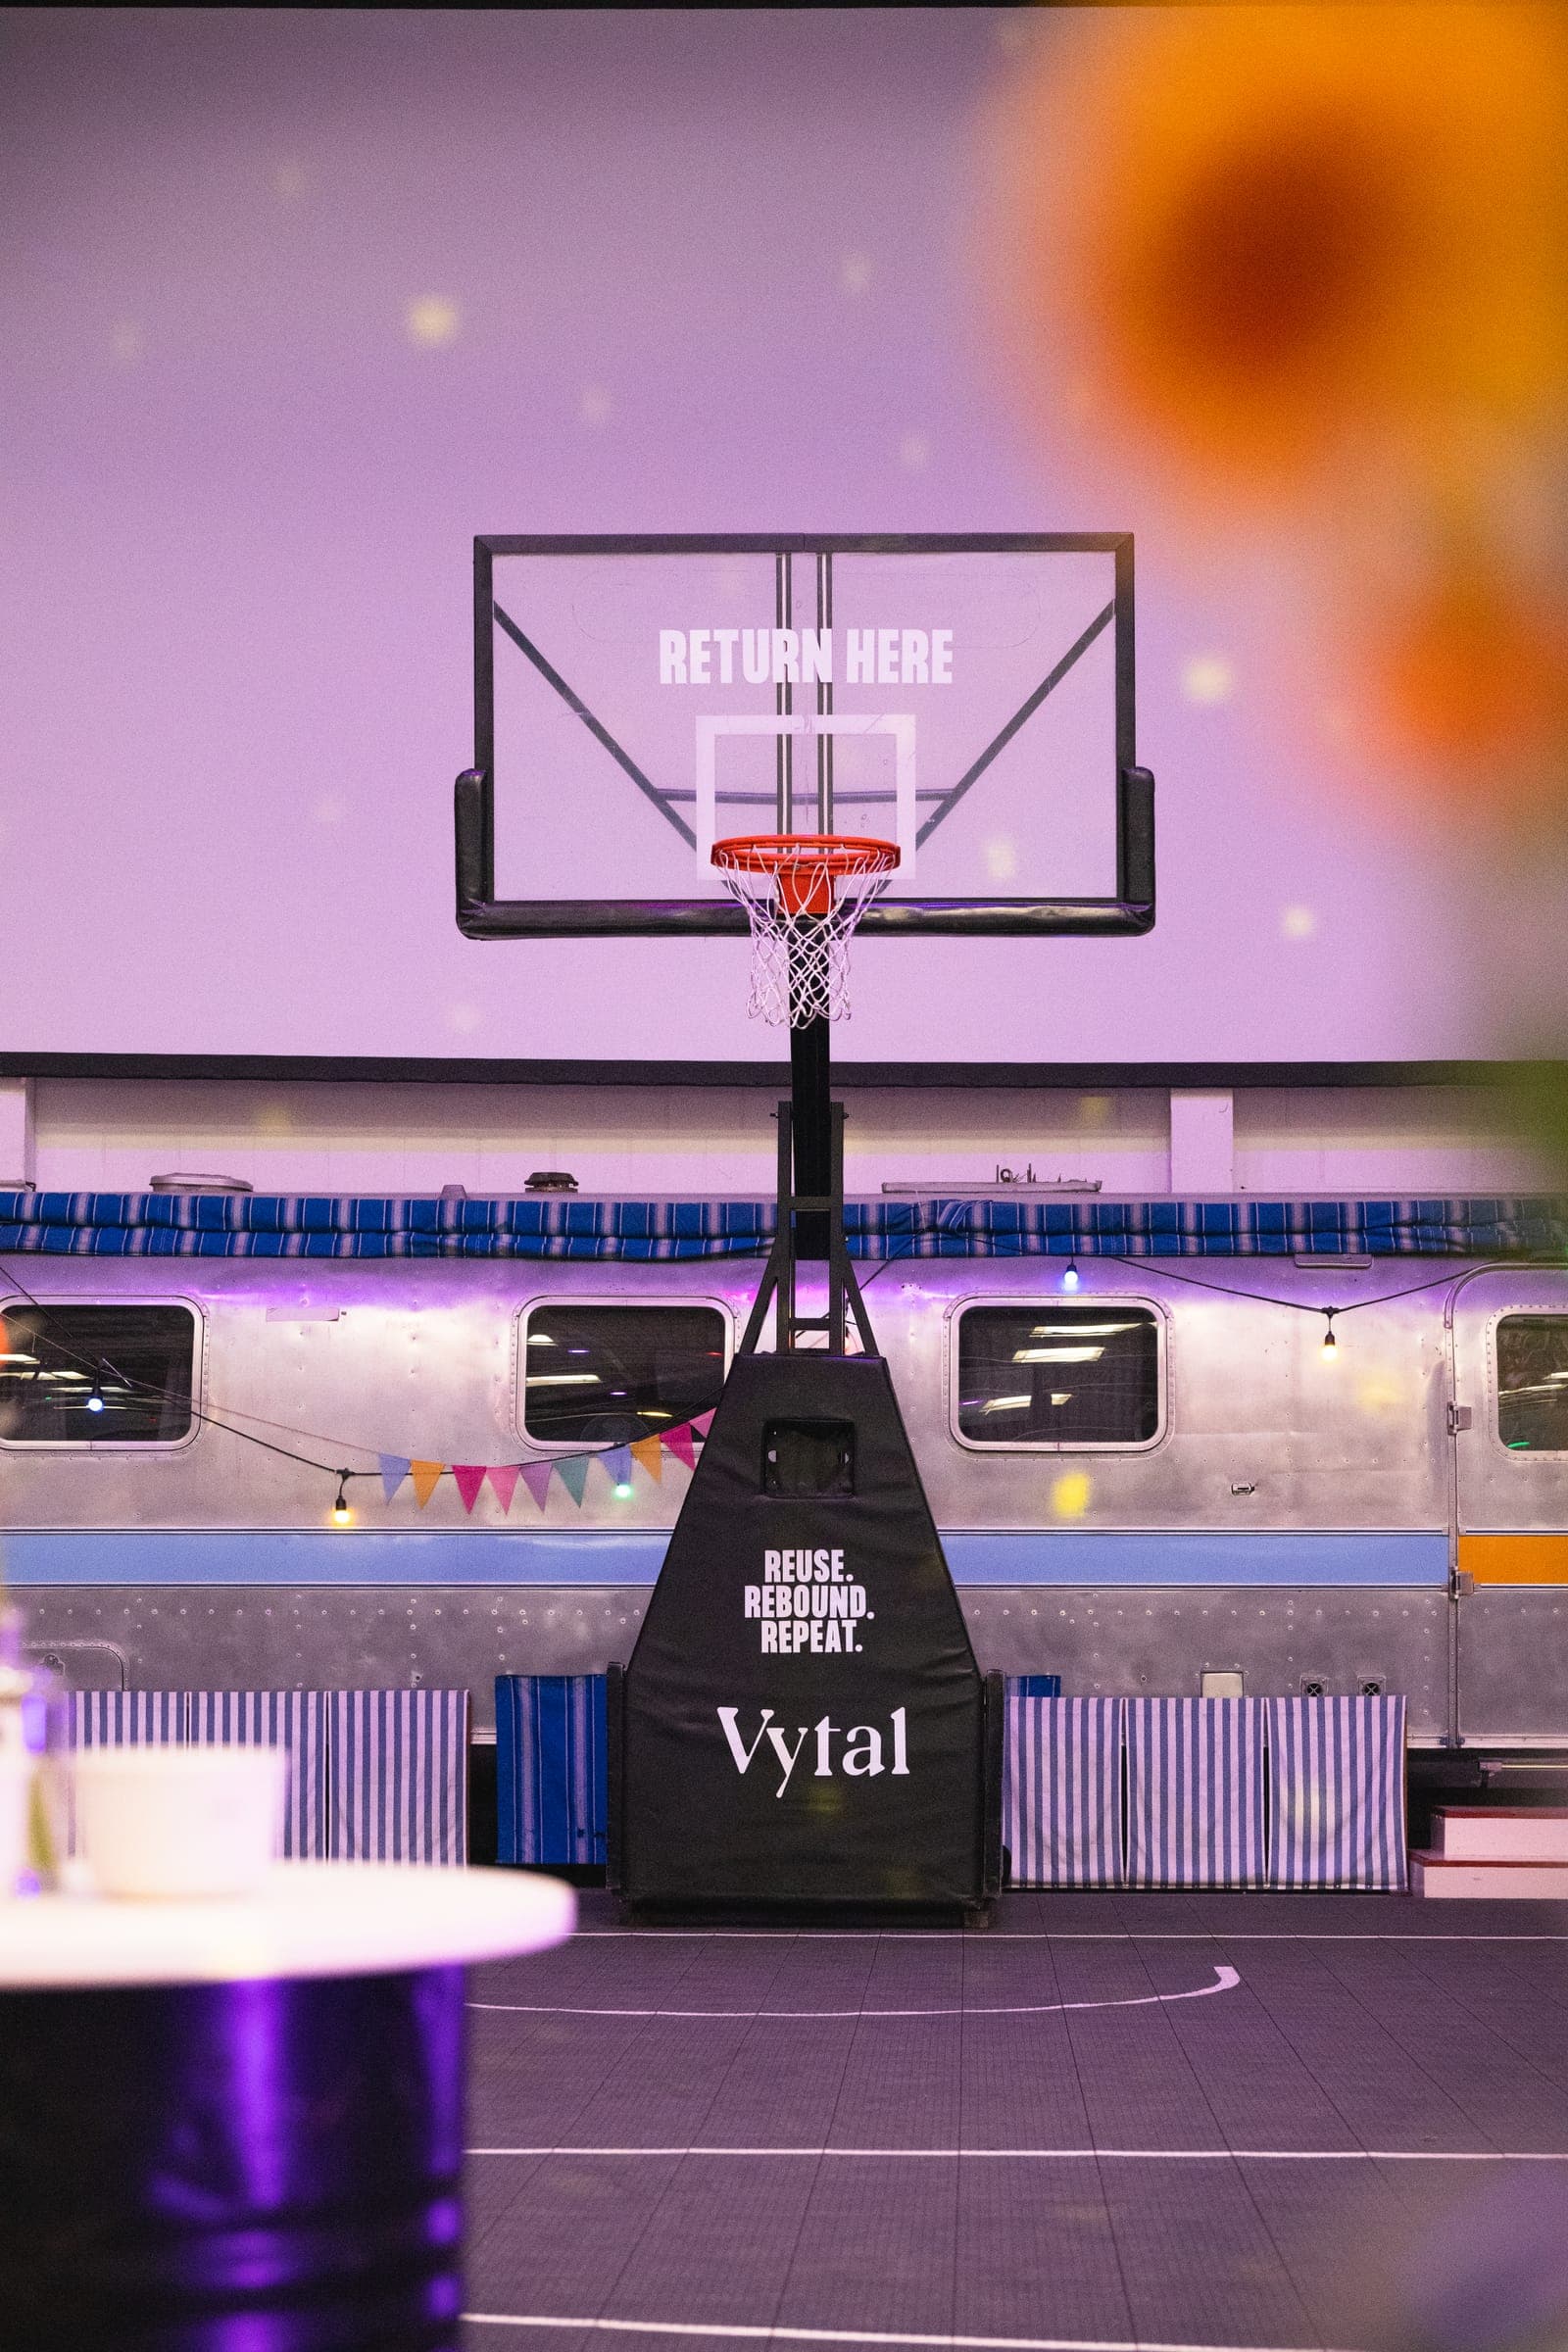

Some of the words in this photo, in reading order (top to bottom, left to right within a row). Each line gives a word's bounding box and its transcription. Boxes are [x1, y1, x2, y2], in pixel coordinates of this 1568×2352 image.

[660, 628, 833, 684] RETURN
[846, 628, 954, 684] HERE
[764, 1549, 854, 1583] REUSE.
[744, 1585, 875, 1620] REBOUND.
[760, 1620, 863, 1653] REPEAT.
[716, 1706, 910, 1798] Vytal
